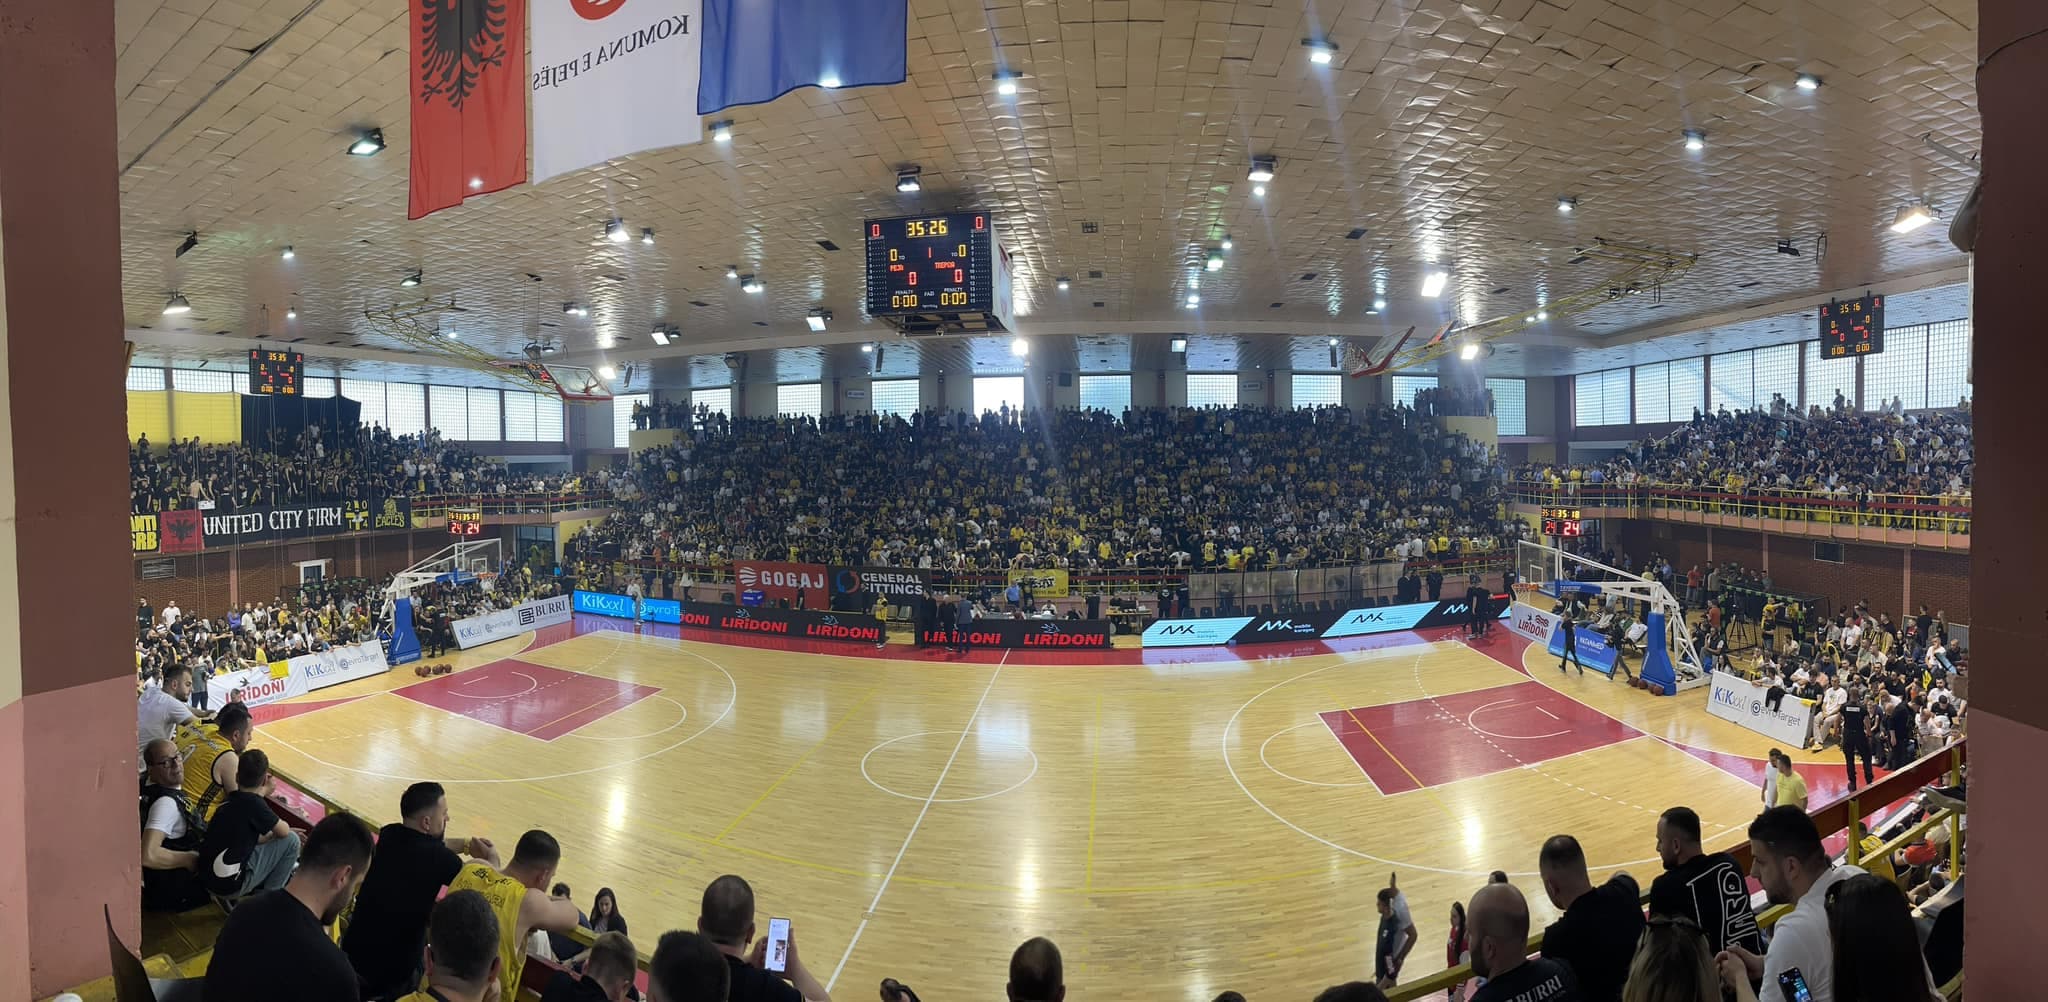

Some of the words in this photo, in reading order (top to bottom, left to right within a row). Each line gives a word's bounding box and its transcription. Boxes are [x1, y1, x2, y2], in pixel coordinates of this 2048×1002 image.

[872, 224, 880, 237] 0
[907, 219, 947, 237] 35:26
[975, 216, 983, 229] 0
[890, 248, 898, 262] 0
[958, 244, 966, 257] 0
[954, 269, 963, 283] 0
[892, 295, 917, 308] 0:00
[345, 501, 351, 511] 2
[361, 500, 368, 510] 0
[203, 512, 263, 536] UNITED
[268, 510, 304, 530] CITY
[307, 507, 343, 527] FIRM
[375, 514, 405, 528] EAGLES
[1557, 509, 1580, 519] 35:18
[451, 522, 462, 534] 24
[467, 522, 480, 535] 24
[1545, 520, 1556, 534] 24
[1563, 521, 1580, 535] 24
[761, 570, 825, 589] GOGAJ
[861, 572, 923, 585] GENERAL
[535, 600, 566, 617] BURRI
[582, 594, 625, 612] KiKxxl
[1714, 686, 1747, 710] KiKxxl
